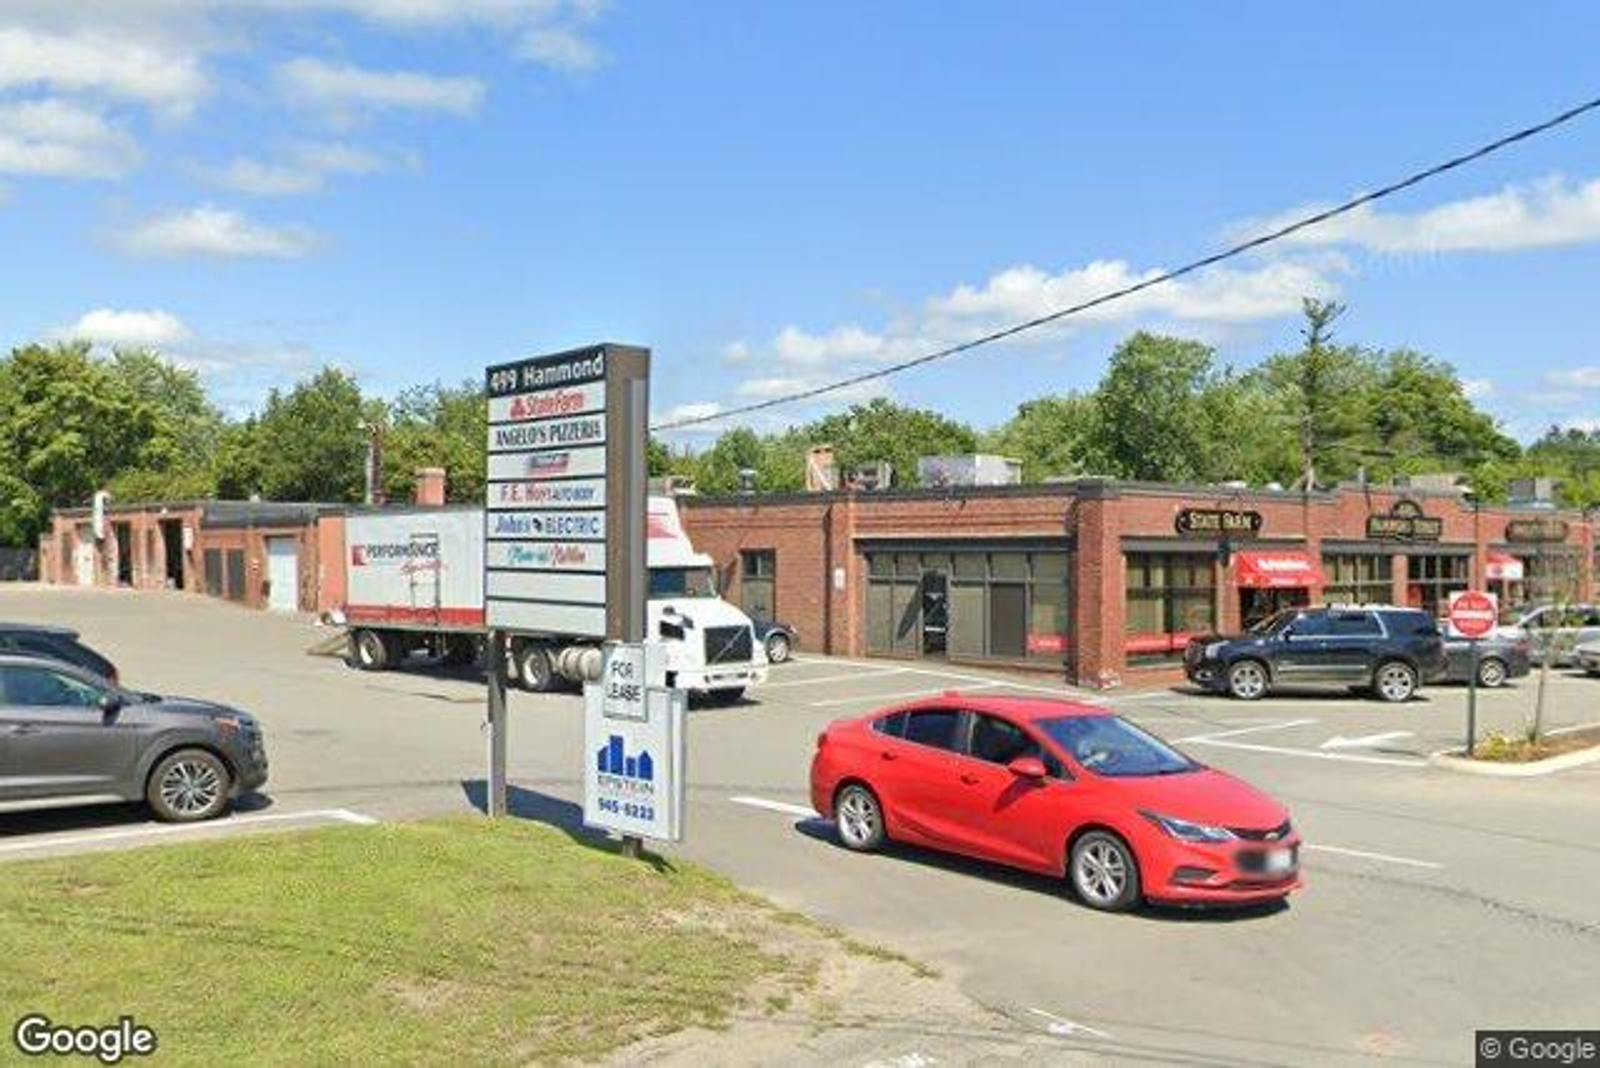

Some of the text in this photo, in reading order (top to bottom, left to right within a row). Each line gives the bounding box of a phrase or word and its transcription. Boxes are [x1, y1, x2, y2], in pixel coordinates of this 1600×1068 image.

[524, 353, 604, 386] Hammond
[549, 419, 601, 443] PIZZERIA
[545, 516, 600, 534] ELECTRIC
[611, 660, 634, 679] FOR
[607, 684, 642, 702] LEASE
